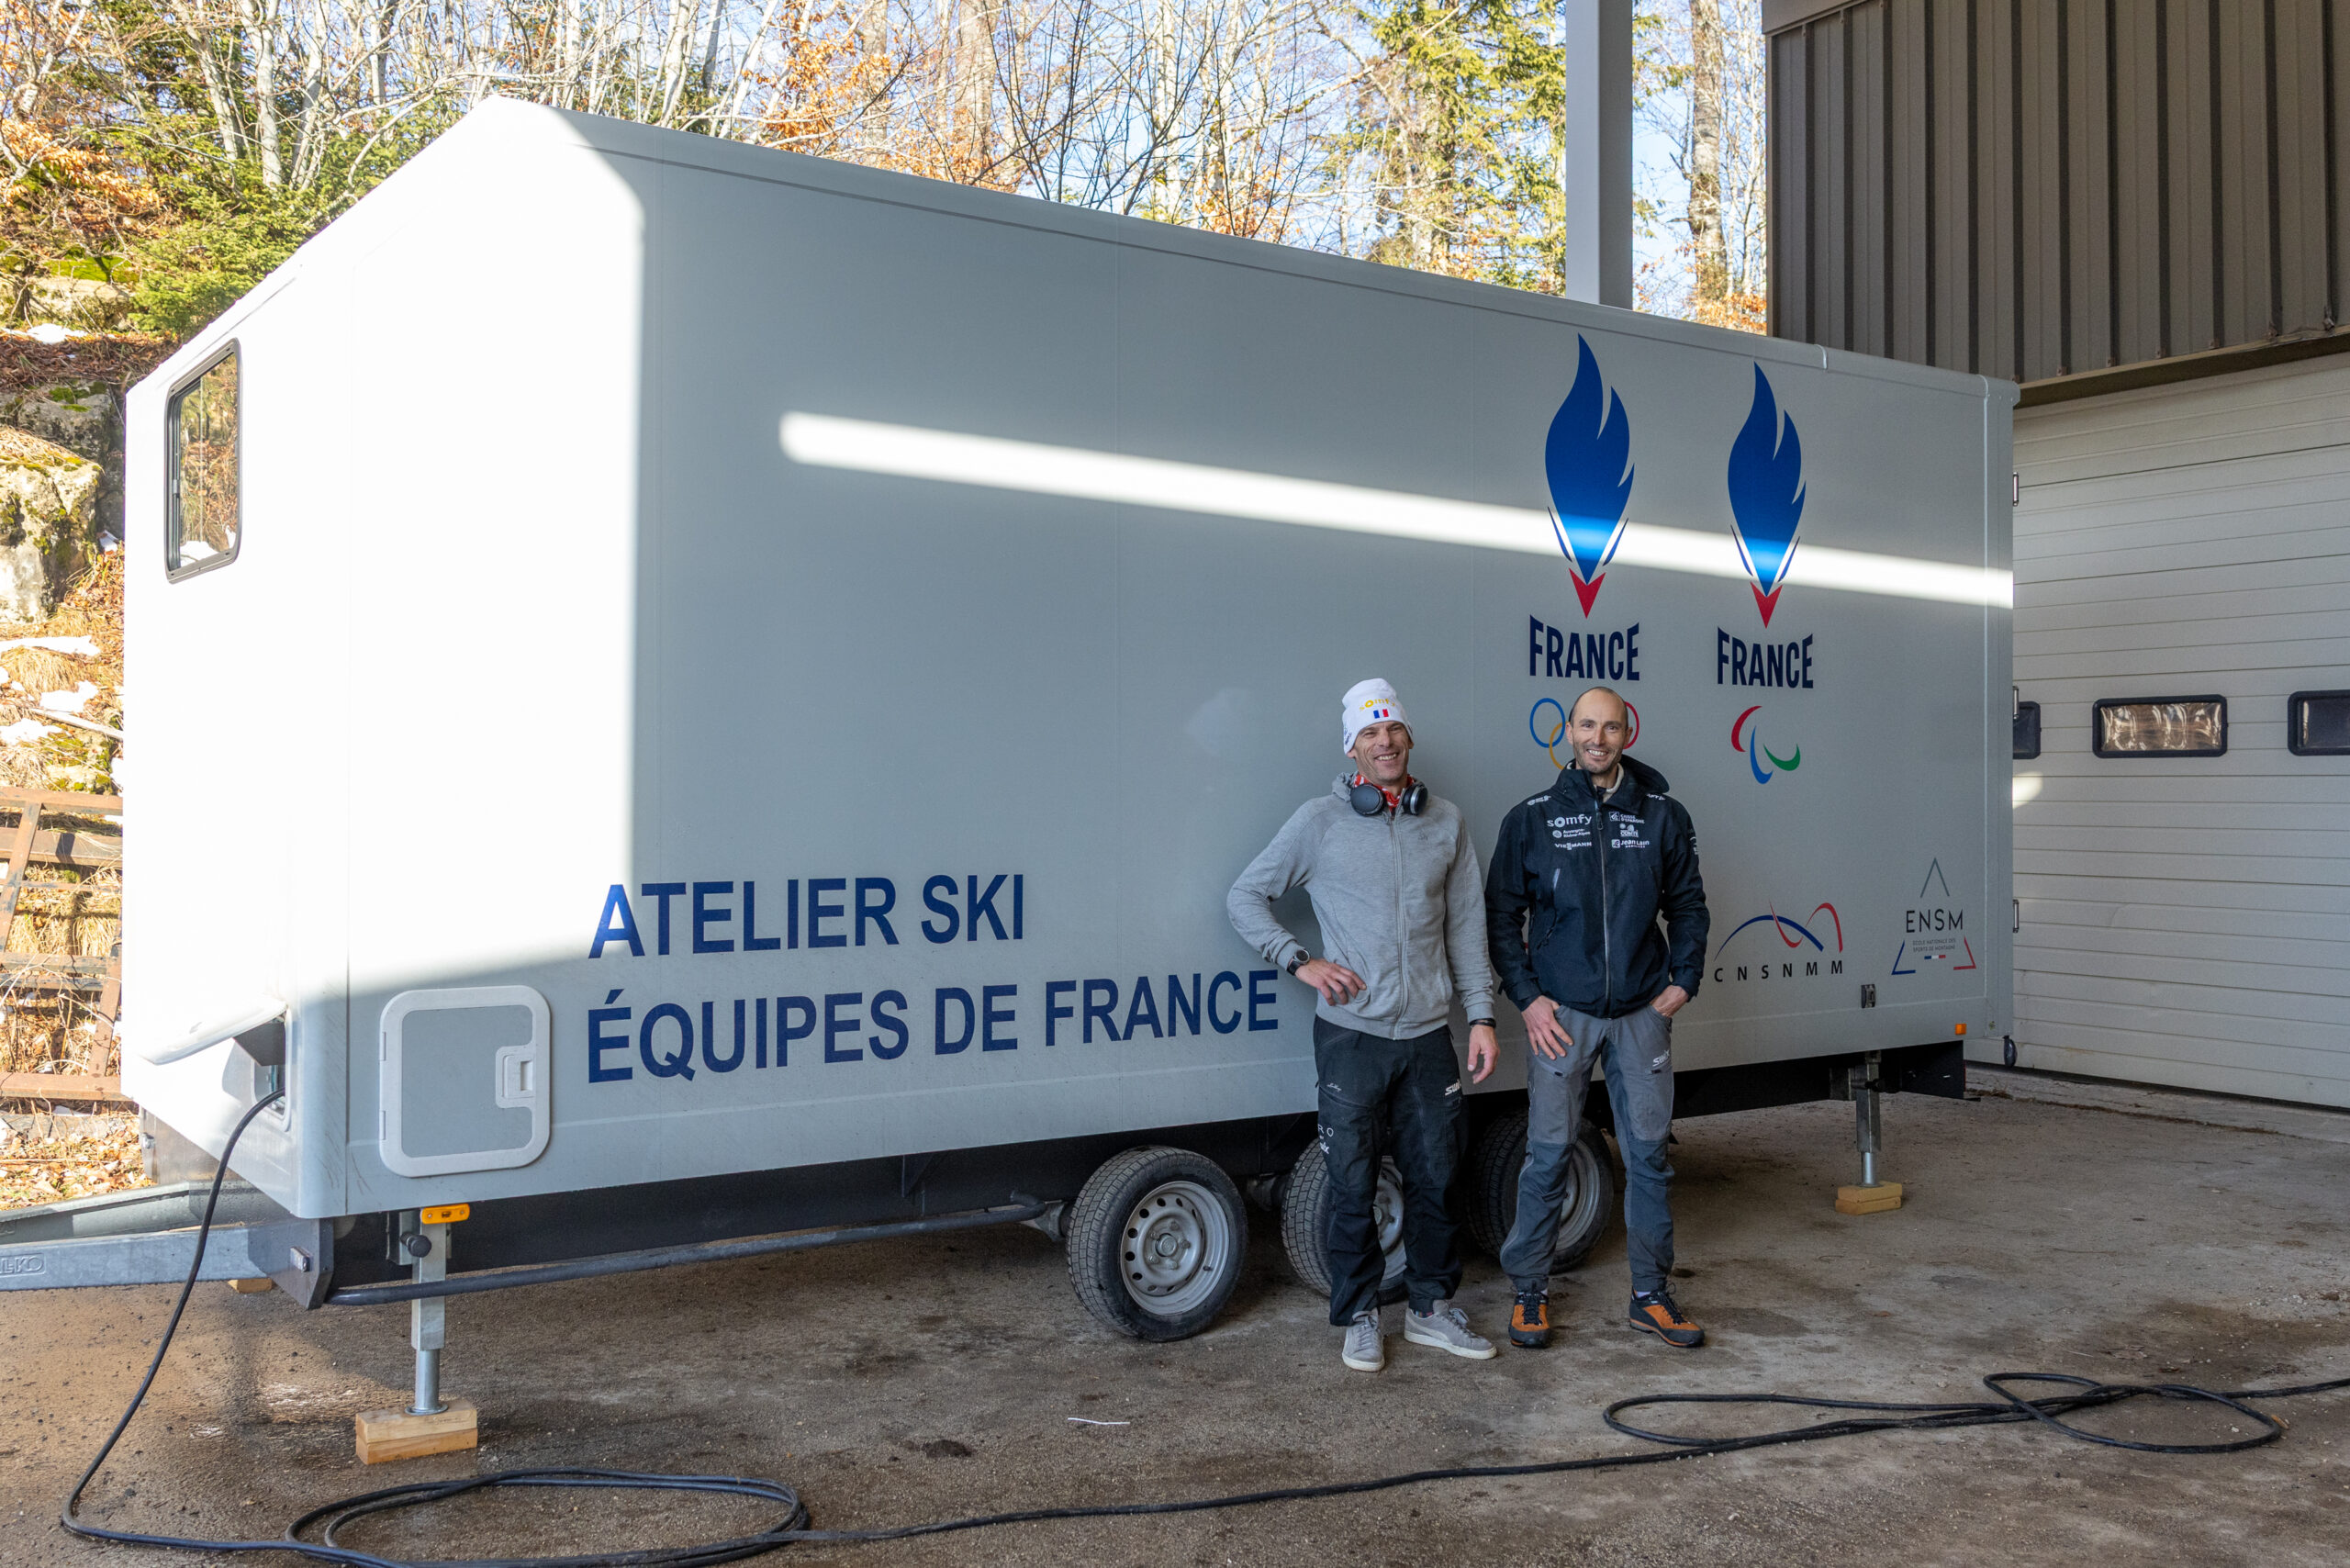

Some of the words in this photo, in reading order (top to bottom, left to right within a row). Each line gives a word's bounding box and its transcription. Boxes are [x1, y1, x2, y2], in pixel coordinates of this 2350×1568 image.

[1529, 614, 1640, 681] FRANCE
[1717, 626, 1814, 689] FRANCE
[1547, 814, 1592, 827] somfy
[588, 876, 901, 959] ATELIER
[921, 873, 1024, 945] SKI
[1906, 908, 1964, 933] ENSM
[588, 989, 910, 1083] ÉQUIPES
[934, 983, 1018, 1056] DE
[1045, 969, 1280, 1047] FRANCE
[0, 1255, 45, 1274] L-KO
